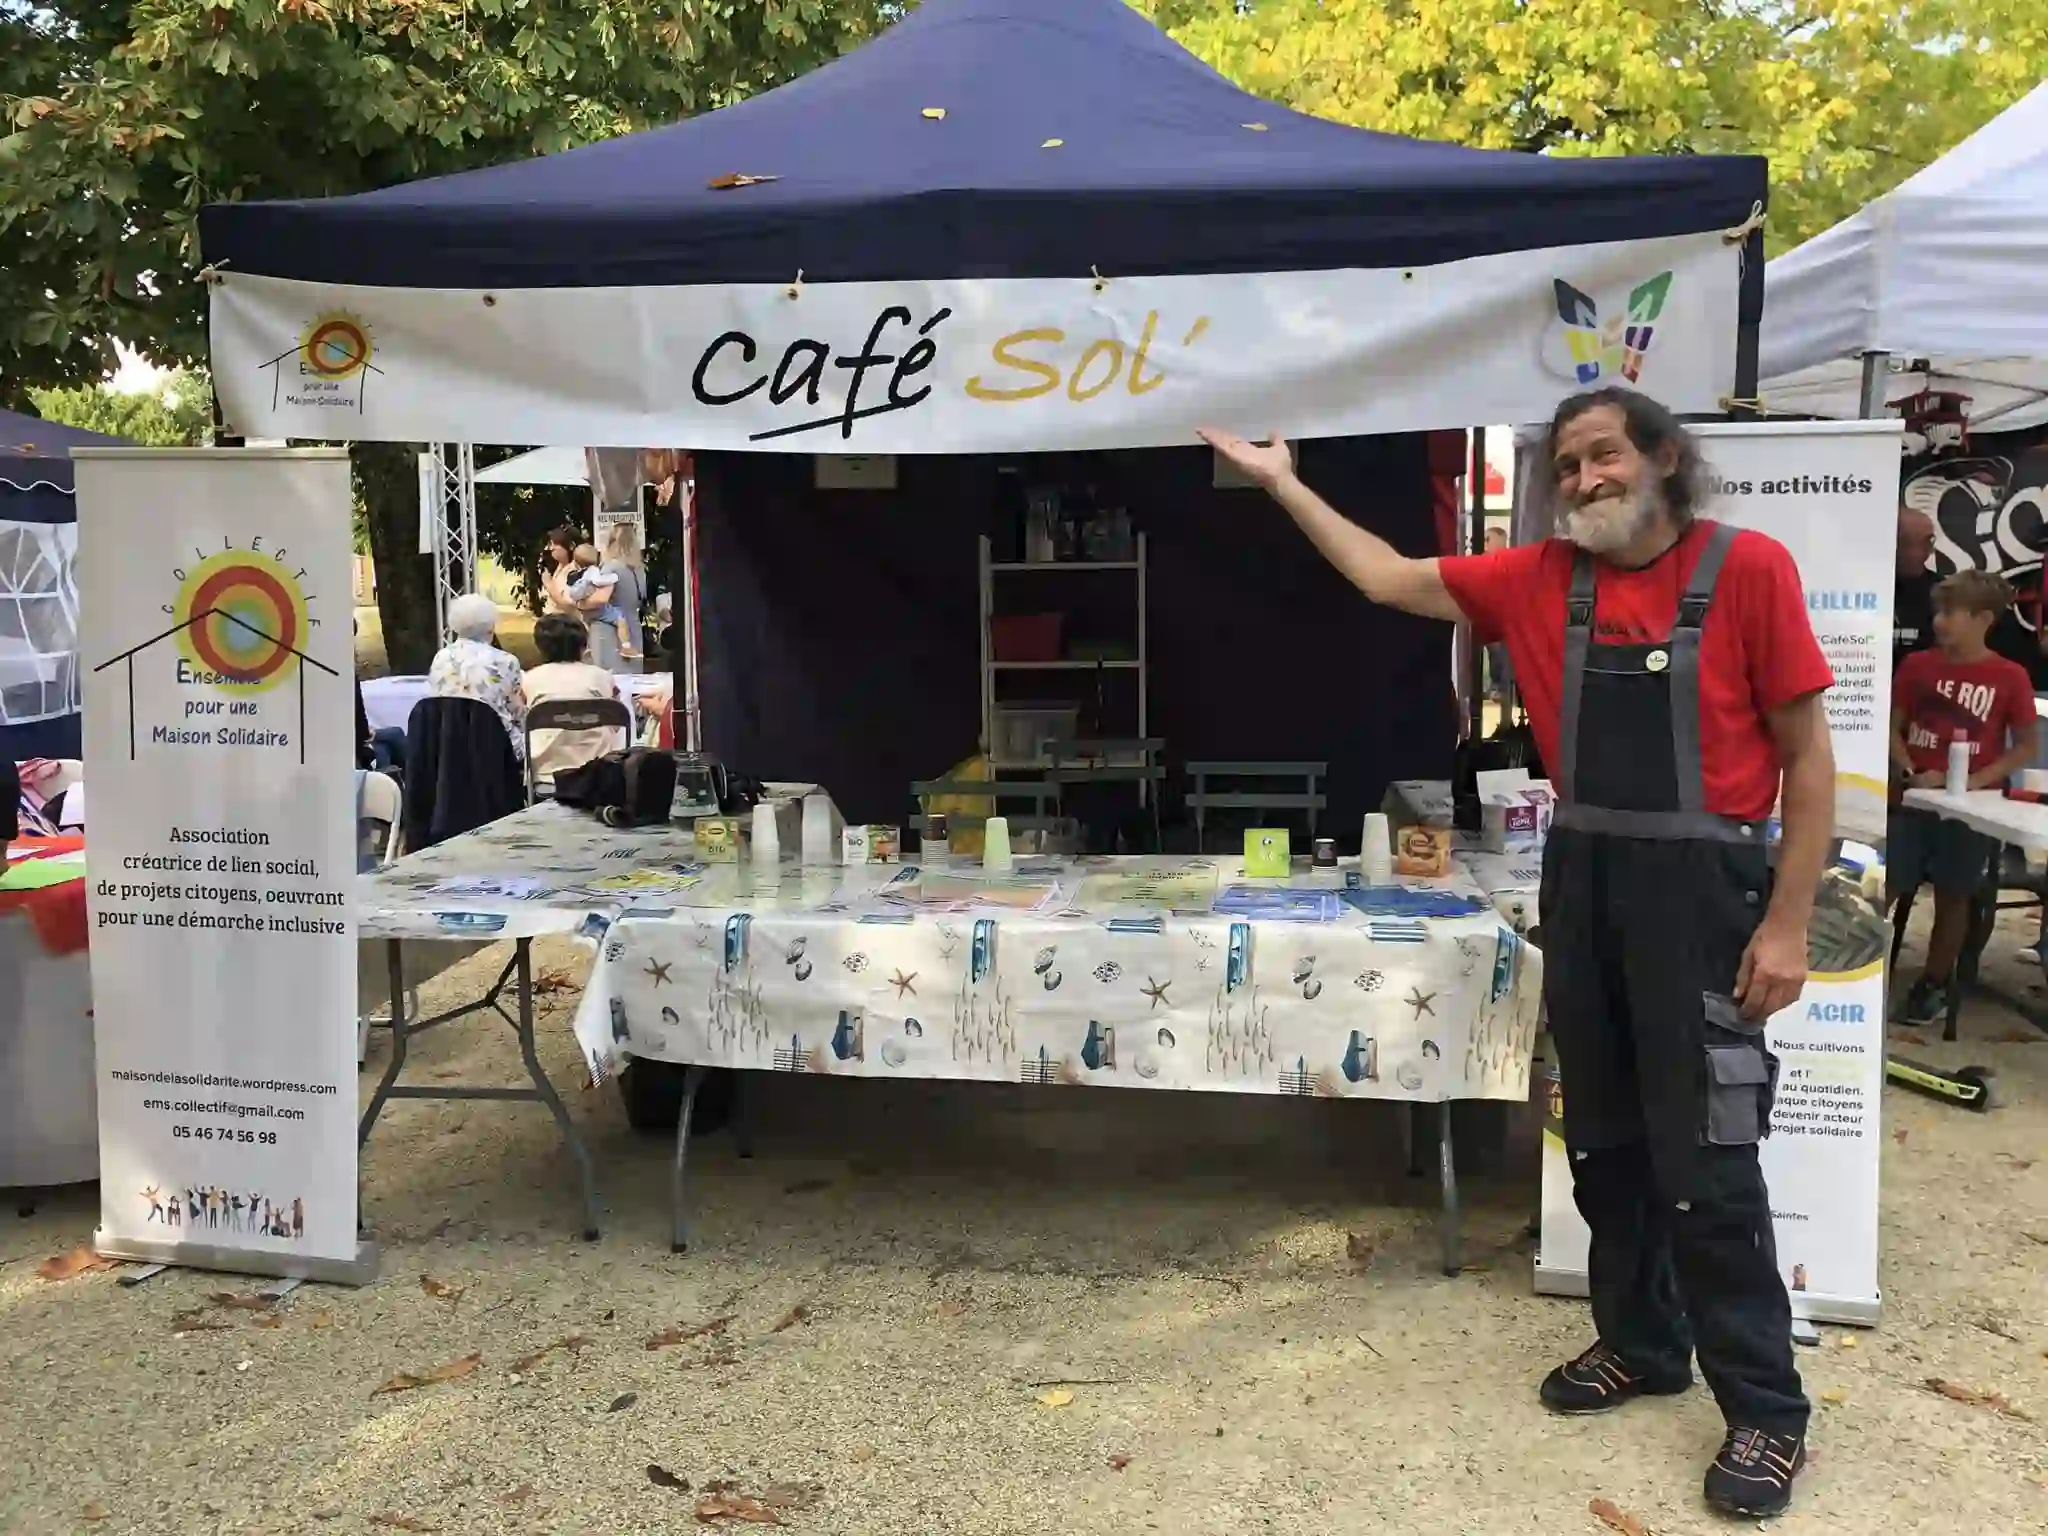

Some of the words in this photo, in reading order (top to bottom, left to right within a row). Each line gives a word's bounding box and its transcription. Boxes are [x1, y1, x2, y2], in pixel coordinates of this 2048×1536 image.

[1760, 473, 1873, 495] activités
[162, 536, 321, 628] COLLECTIF
[1808, 590, 1878, 611] EILLIR
[185, 701, 224, 718] pour
[229, 702, 257, 715] une
[1936, 680, 1955, 699] LE
[1958, 681, 1996, 722] ROI
[152, 725, 211, 745] Maison
[217, 727, 289, 747] Solidaire
[1831, 721, 1873, 731] esoins.
[169, 827, 270, 845] Association
[123, 853, 202, 872] créatrice
[207, 856, 227, 872] de
[232, 856, 261, 873] lien
[266, 858, 319, 879] social,
[97, 880, 117, 896] de
[121, 881, 181, 902] projets
[185, 884, 262, 905] citoyens,
[265, 889, 345, 906] oeuvrant
[98, 910, 138, 928] pour
[142, 912, 174, 928] une
[178, 910, 264, 931] démarche
[268, 916, 345, 935] inclusive
[1773, 1039, 1805, 1051] Nous
[1808, 1041, 1865, 1053] cultivons
[112, 1069, 337, 1095] maisondelasolidarite.wordpress.com
[1789, 1068, 1802, 1078] et
[1781, 1084, 1797, 1092] au
[1800, 1083, 1865, 1096] quotidien.
[143, 1098, 305, 1121] ems.collectif@gmail.com
[1811, 1096, 1864, 1110] citoyens
[1773, 1108, 1820, 1121] devenir
[1823, 1111, 1863, 1124] acteur
[172, 1126, 191, 1139] 05
[194, 1127, 213, 1140] 46
[217, 1128, 234, 1141] 74
[237, 1130, 254, 1143] 56
[258, 1131, 277, 1145] 98
[1809, 1124, 1863, 1138] solidaire
